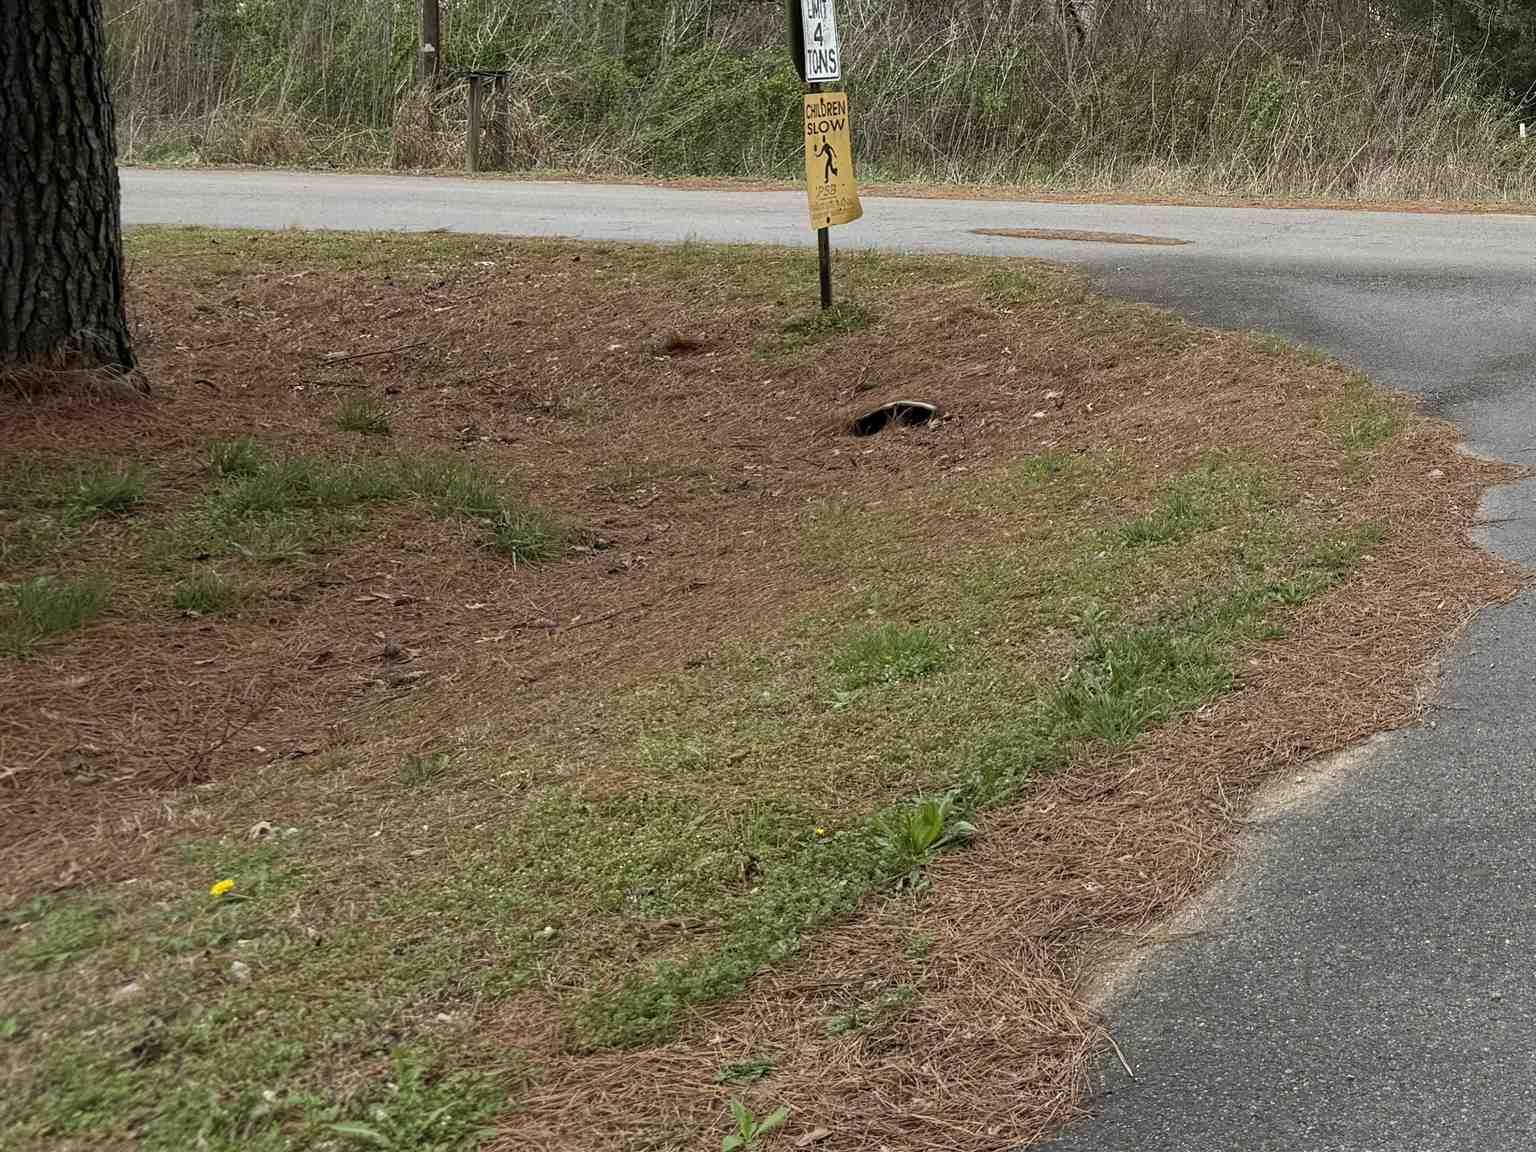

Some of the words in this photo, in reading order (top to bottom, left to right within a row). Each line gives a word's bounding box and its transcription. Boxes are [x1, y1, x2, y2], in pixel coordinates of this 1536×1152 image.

[806, 0, 828, 19] LIMIT
[814, 23, 823, 46] 4
[808, 49, 837, 74] TONS
[806, 100, 846, 119] CHILDREN
[807, 119, 845, 136] SLOW
